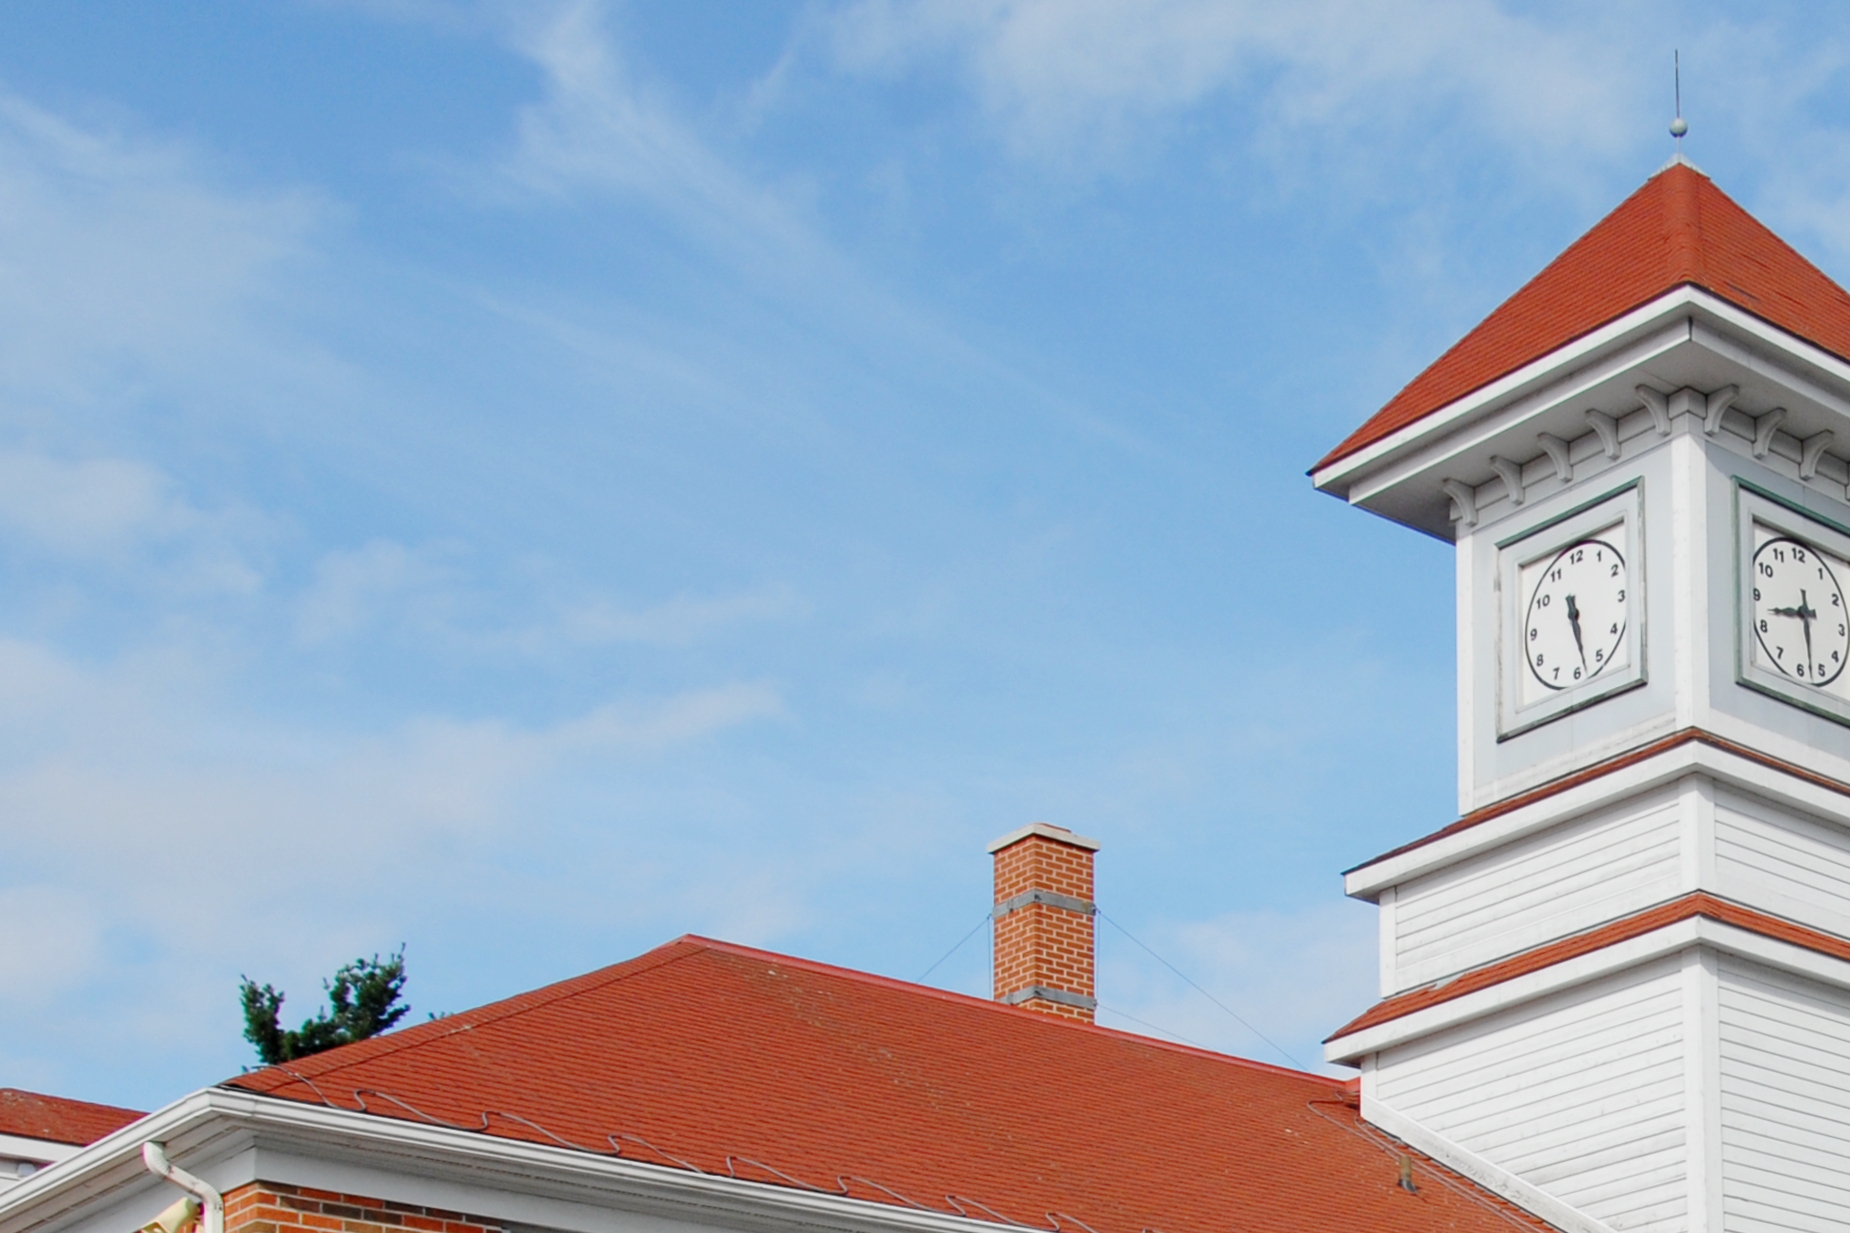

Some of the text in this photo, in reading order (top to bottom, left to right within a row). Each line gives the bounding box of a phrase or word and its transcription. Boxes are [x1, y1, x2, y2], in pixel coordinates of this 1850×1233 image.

[1569, 549, 1584, 565] 12
[1596, 550, 1602, 562] 1
[1773, 548, 1785, 563] 11
[1791, 547, 1806, 564] 12
[1550, 568, 1562, 582] 11
[1611, 563, 1619, 577] 2
[1758, 561, 1774, 578] 10
[1818, 567, 1824, 580] 1
[1536, 594, 1551, 609] 10
[1618, 589, 1626, 603] 3
[1753, 587, 1762, 602] 9
[1831, 593, 1840, 607] 2
[1610, 622, 1618, 635] 4
[1759, 619, 1769, 634] 8
[1838, 623, 1846, 637] 3
[1530, 628, 1538, 641] 9
[1595, 649, 1604, 662] 5
[1776, 646, 1784, 660] 7
[1831, 650, 1840, 663] 4
[1536, 654, 1544, 667] 8
[1552, 667, 1560, 680] 7
[1573, 667, 1582, 680] 6
[1796, 663, 1805, 677] 6
[1817, 663, 1826, 677] 5
